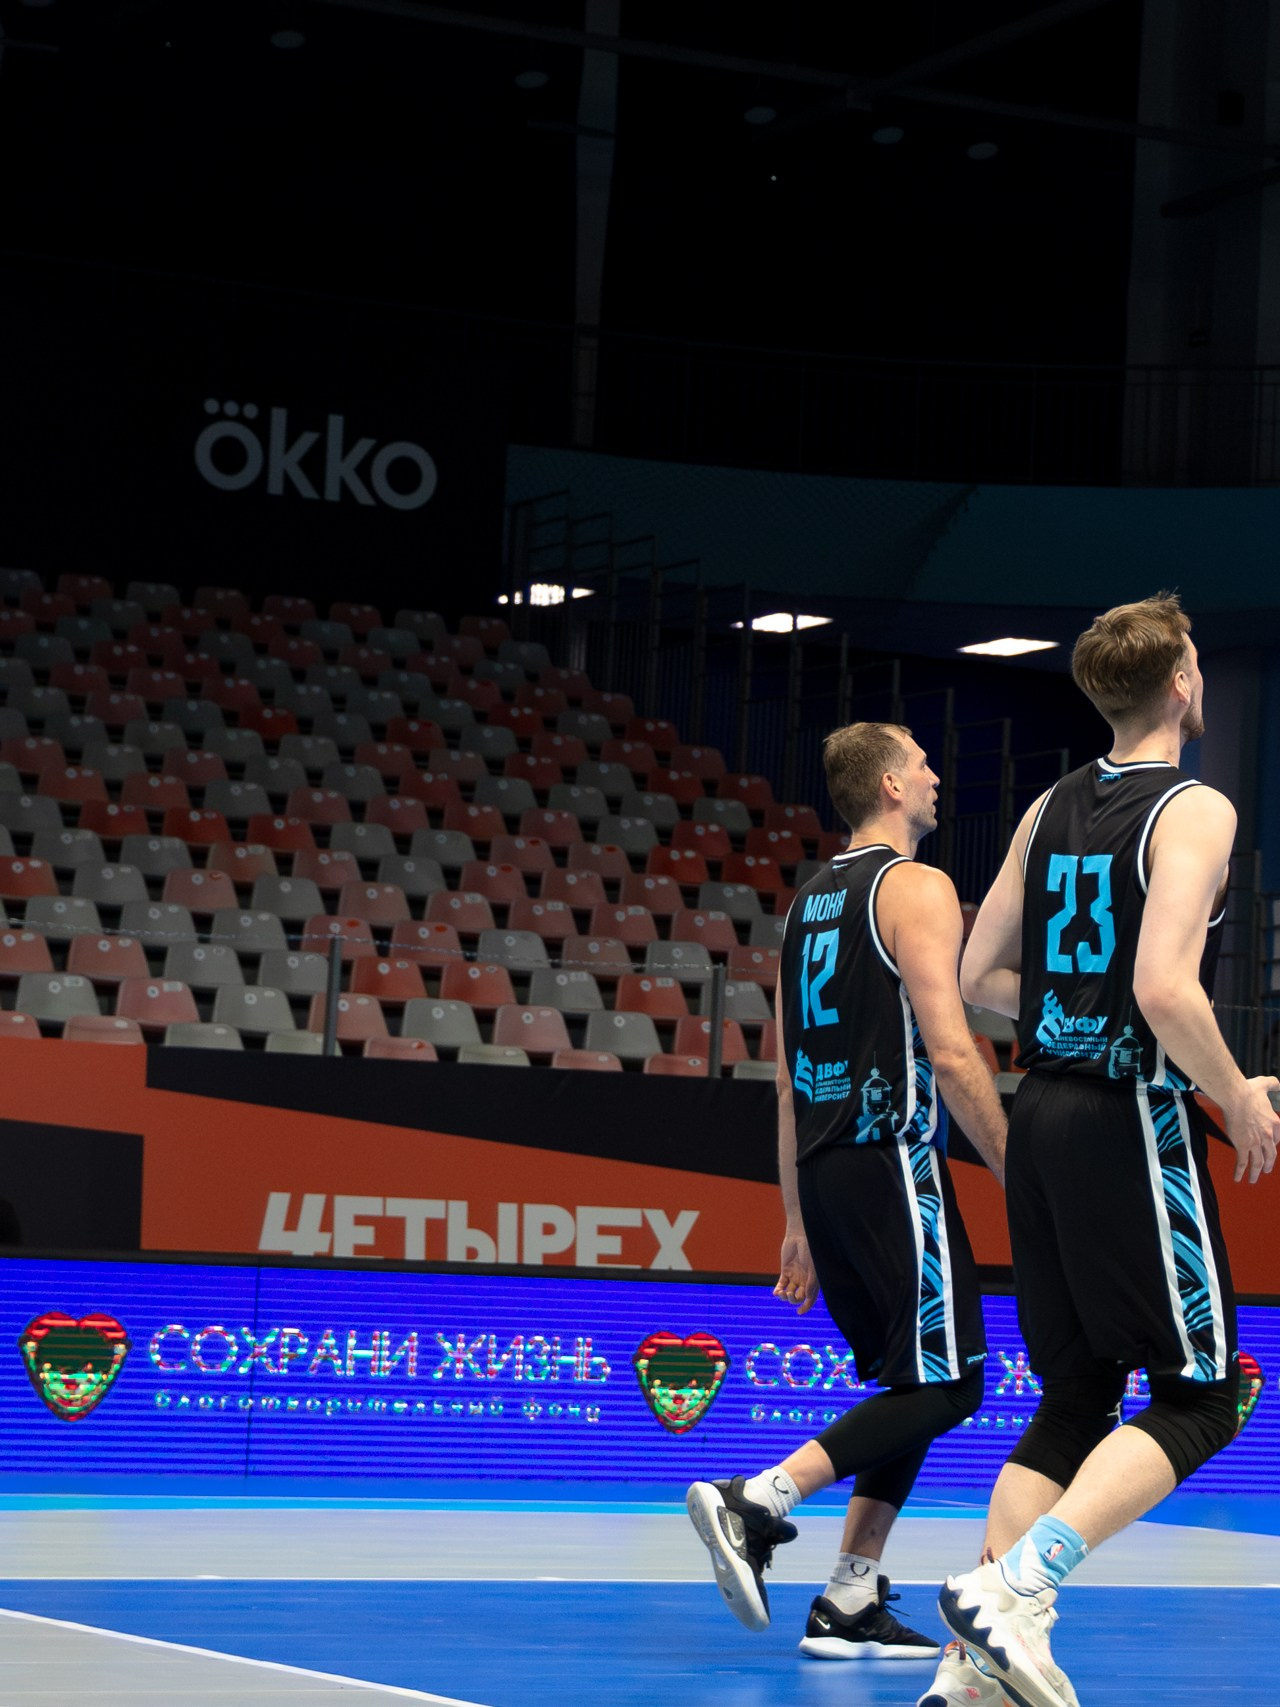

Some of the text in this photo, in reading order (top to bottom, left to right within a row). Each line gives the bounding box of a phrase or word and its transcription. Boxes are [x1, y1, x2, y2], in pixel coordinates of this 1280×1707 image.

[802, 887, 848, 924] МОНЯ
[1047, 854, 1116, 974] 23
[801, 927, 840, 1029] 12
[149, 1323, 611, 1384] СОХРАНИ ЖИЗНЬ
